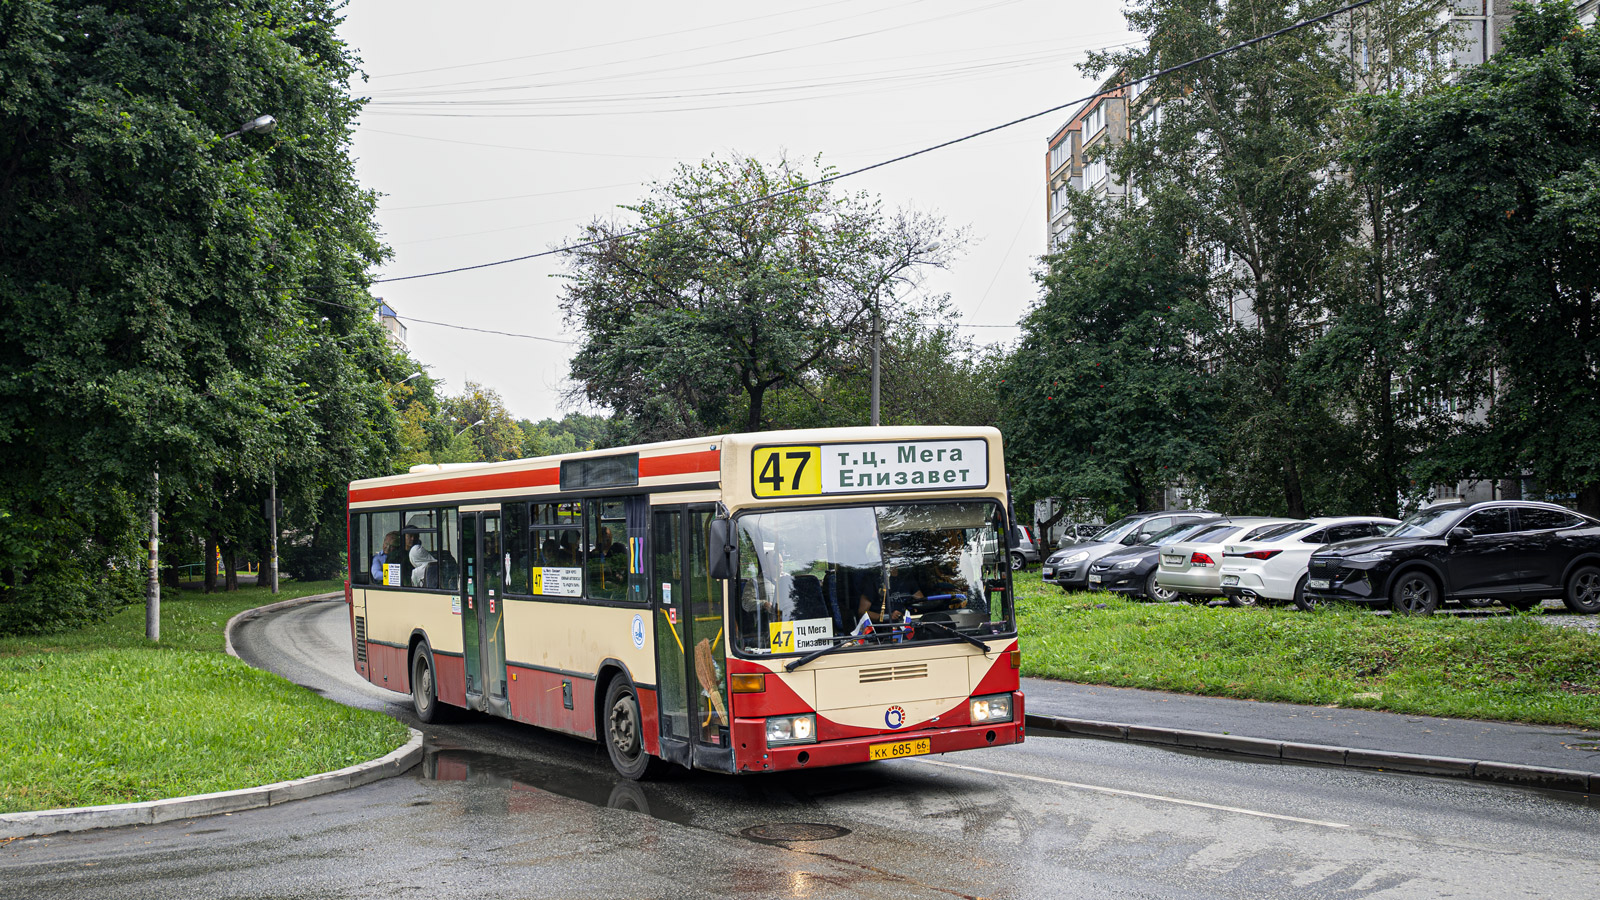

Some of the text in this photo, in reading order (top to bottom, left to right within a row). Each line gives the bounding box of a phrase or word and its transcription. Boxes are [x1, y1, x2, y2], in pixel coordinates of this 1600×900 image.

[838, 445, 963, 468] т.ц. Мега
[759, 451, 811, 492] 47
[839, 468, 970, 488] Елизавет
[772, 631, 792, 648] 47
[797, 626, 826, 636] ТЦ Мега
[892, 743, 911, 755] 685
[917, 741, 926, 749] 66
